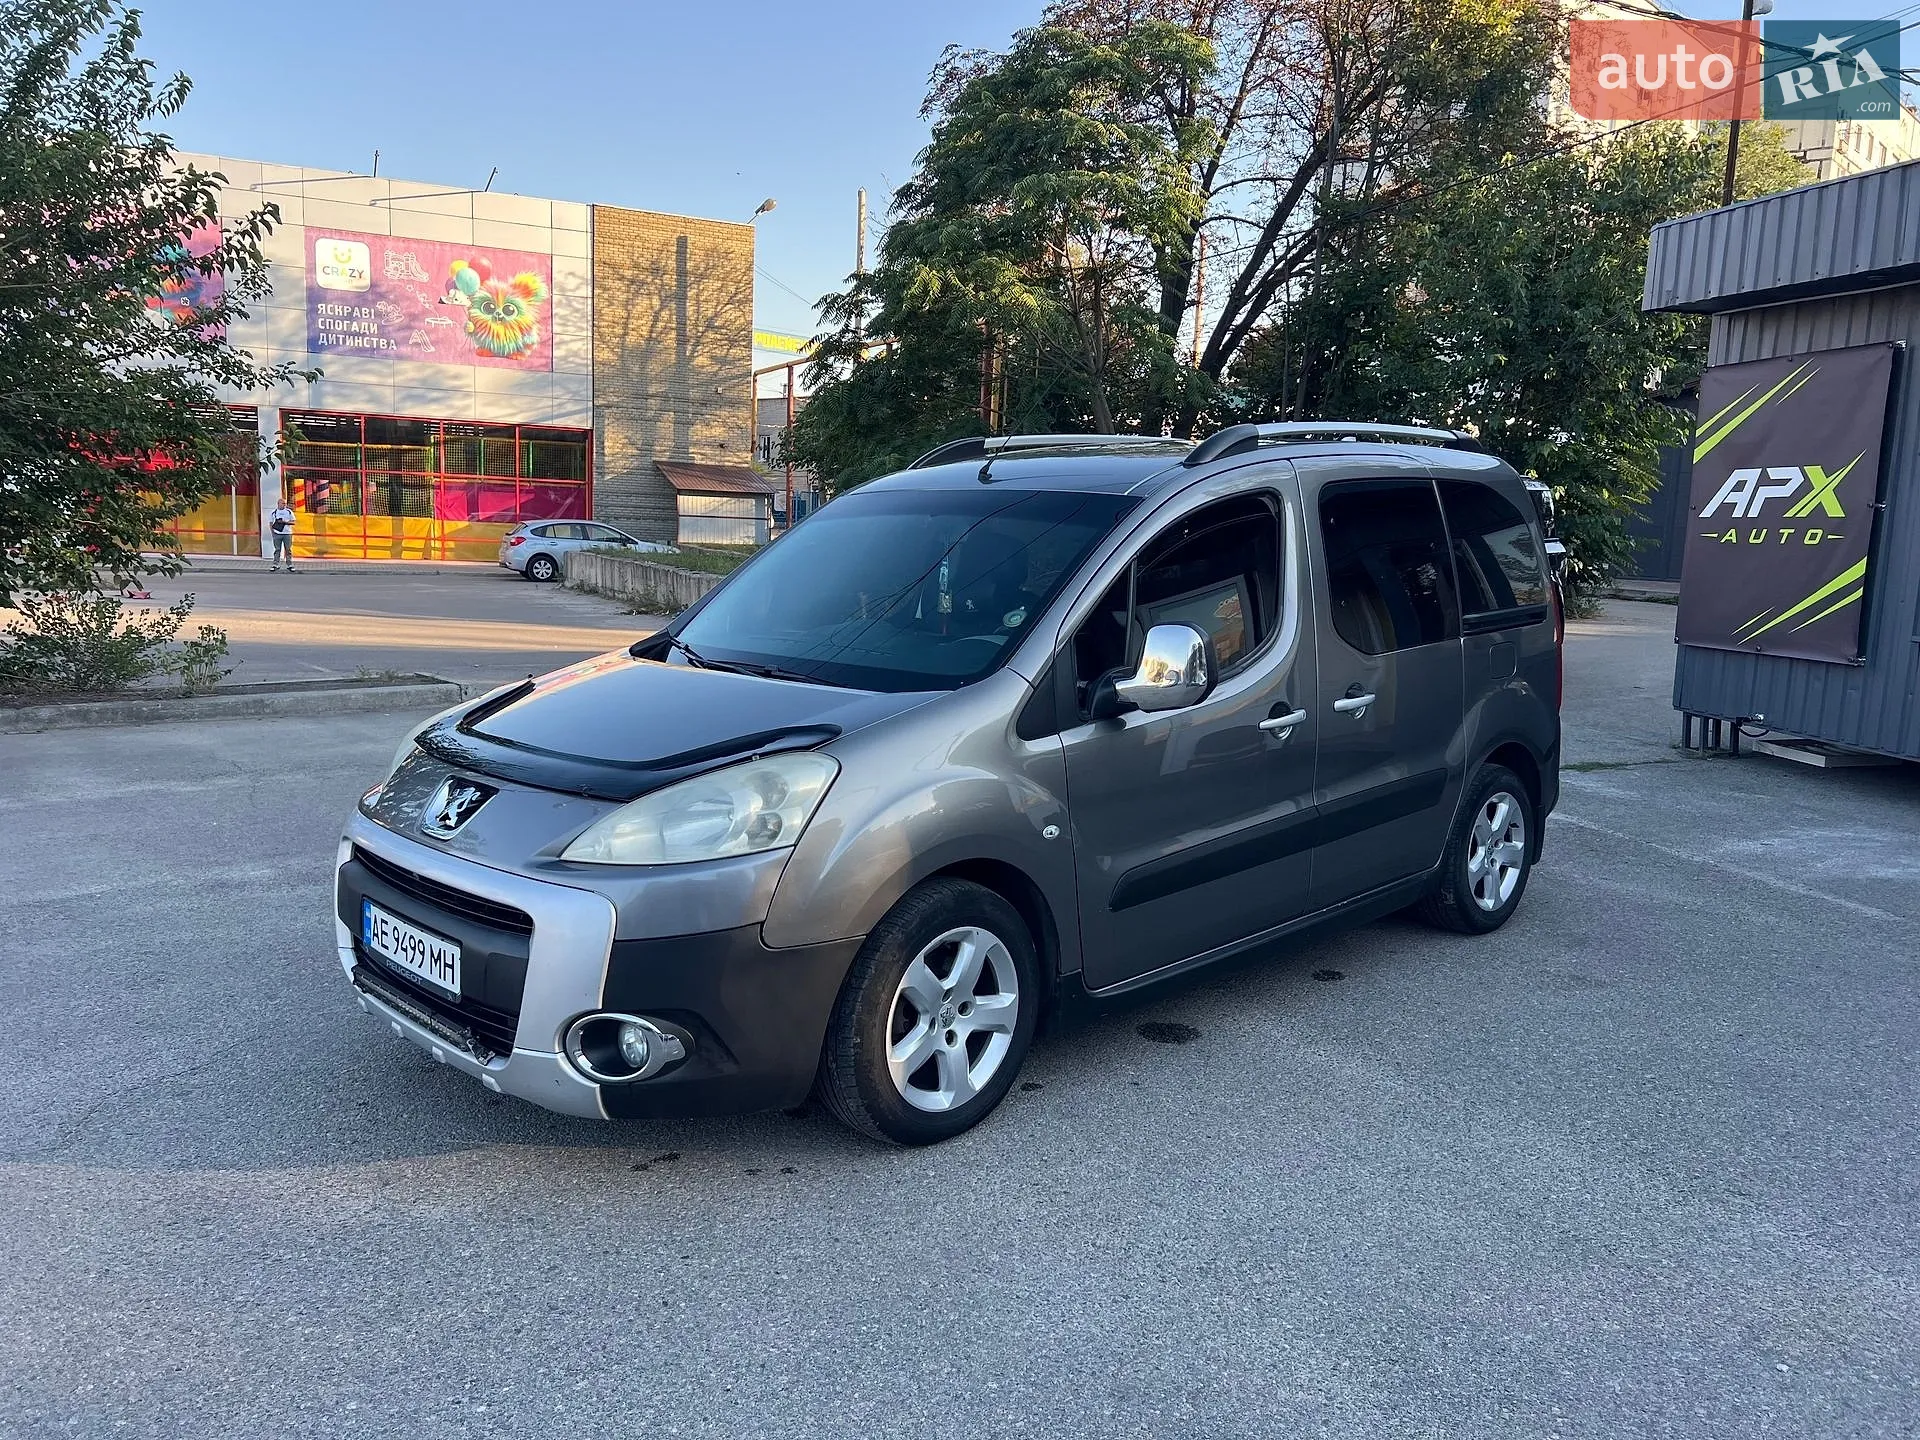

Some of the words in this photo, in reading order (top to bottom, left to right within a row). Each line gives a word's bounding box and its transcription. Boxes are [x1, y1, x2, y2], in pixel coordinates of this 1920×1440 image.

[322, 265, 365, 279] CRAZY
[317, 303, 376, 319] ЯСКРАВІ
[318, 318, 378, 335] СПОГАДИ
[318, 333, 398, 351] ДИТИНСТВА
[1698, 448, 1867, 518] APX
[1719, 528, 1824, 545] AUTO
[372, 914, 389, 950] AE
[392, 926, 426, 968] 9499
[429, 943, 455, 985] MH
[386, 960, 422, 985] PEUGEOT
